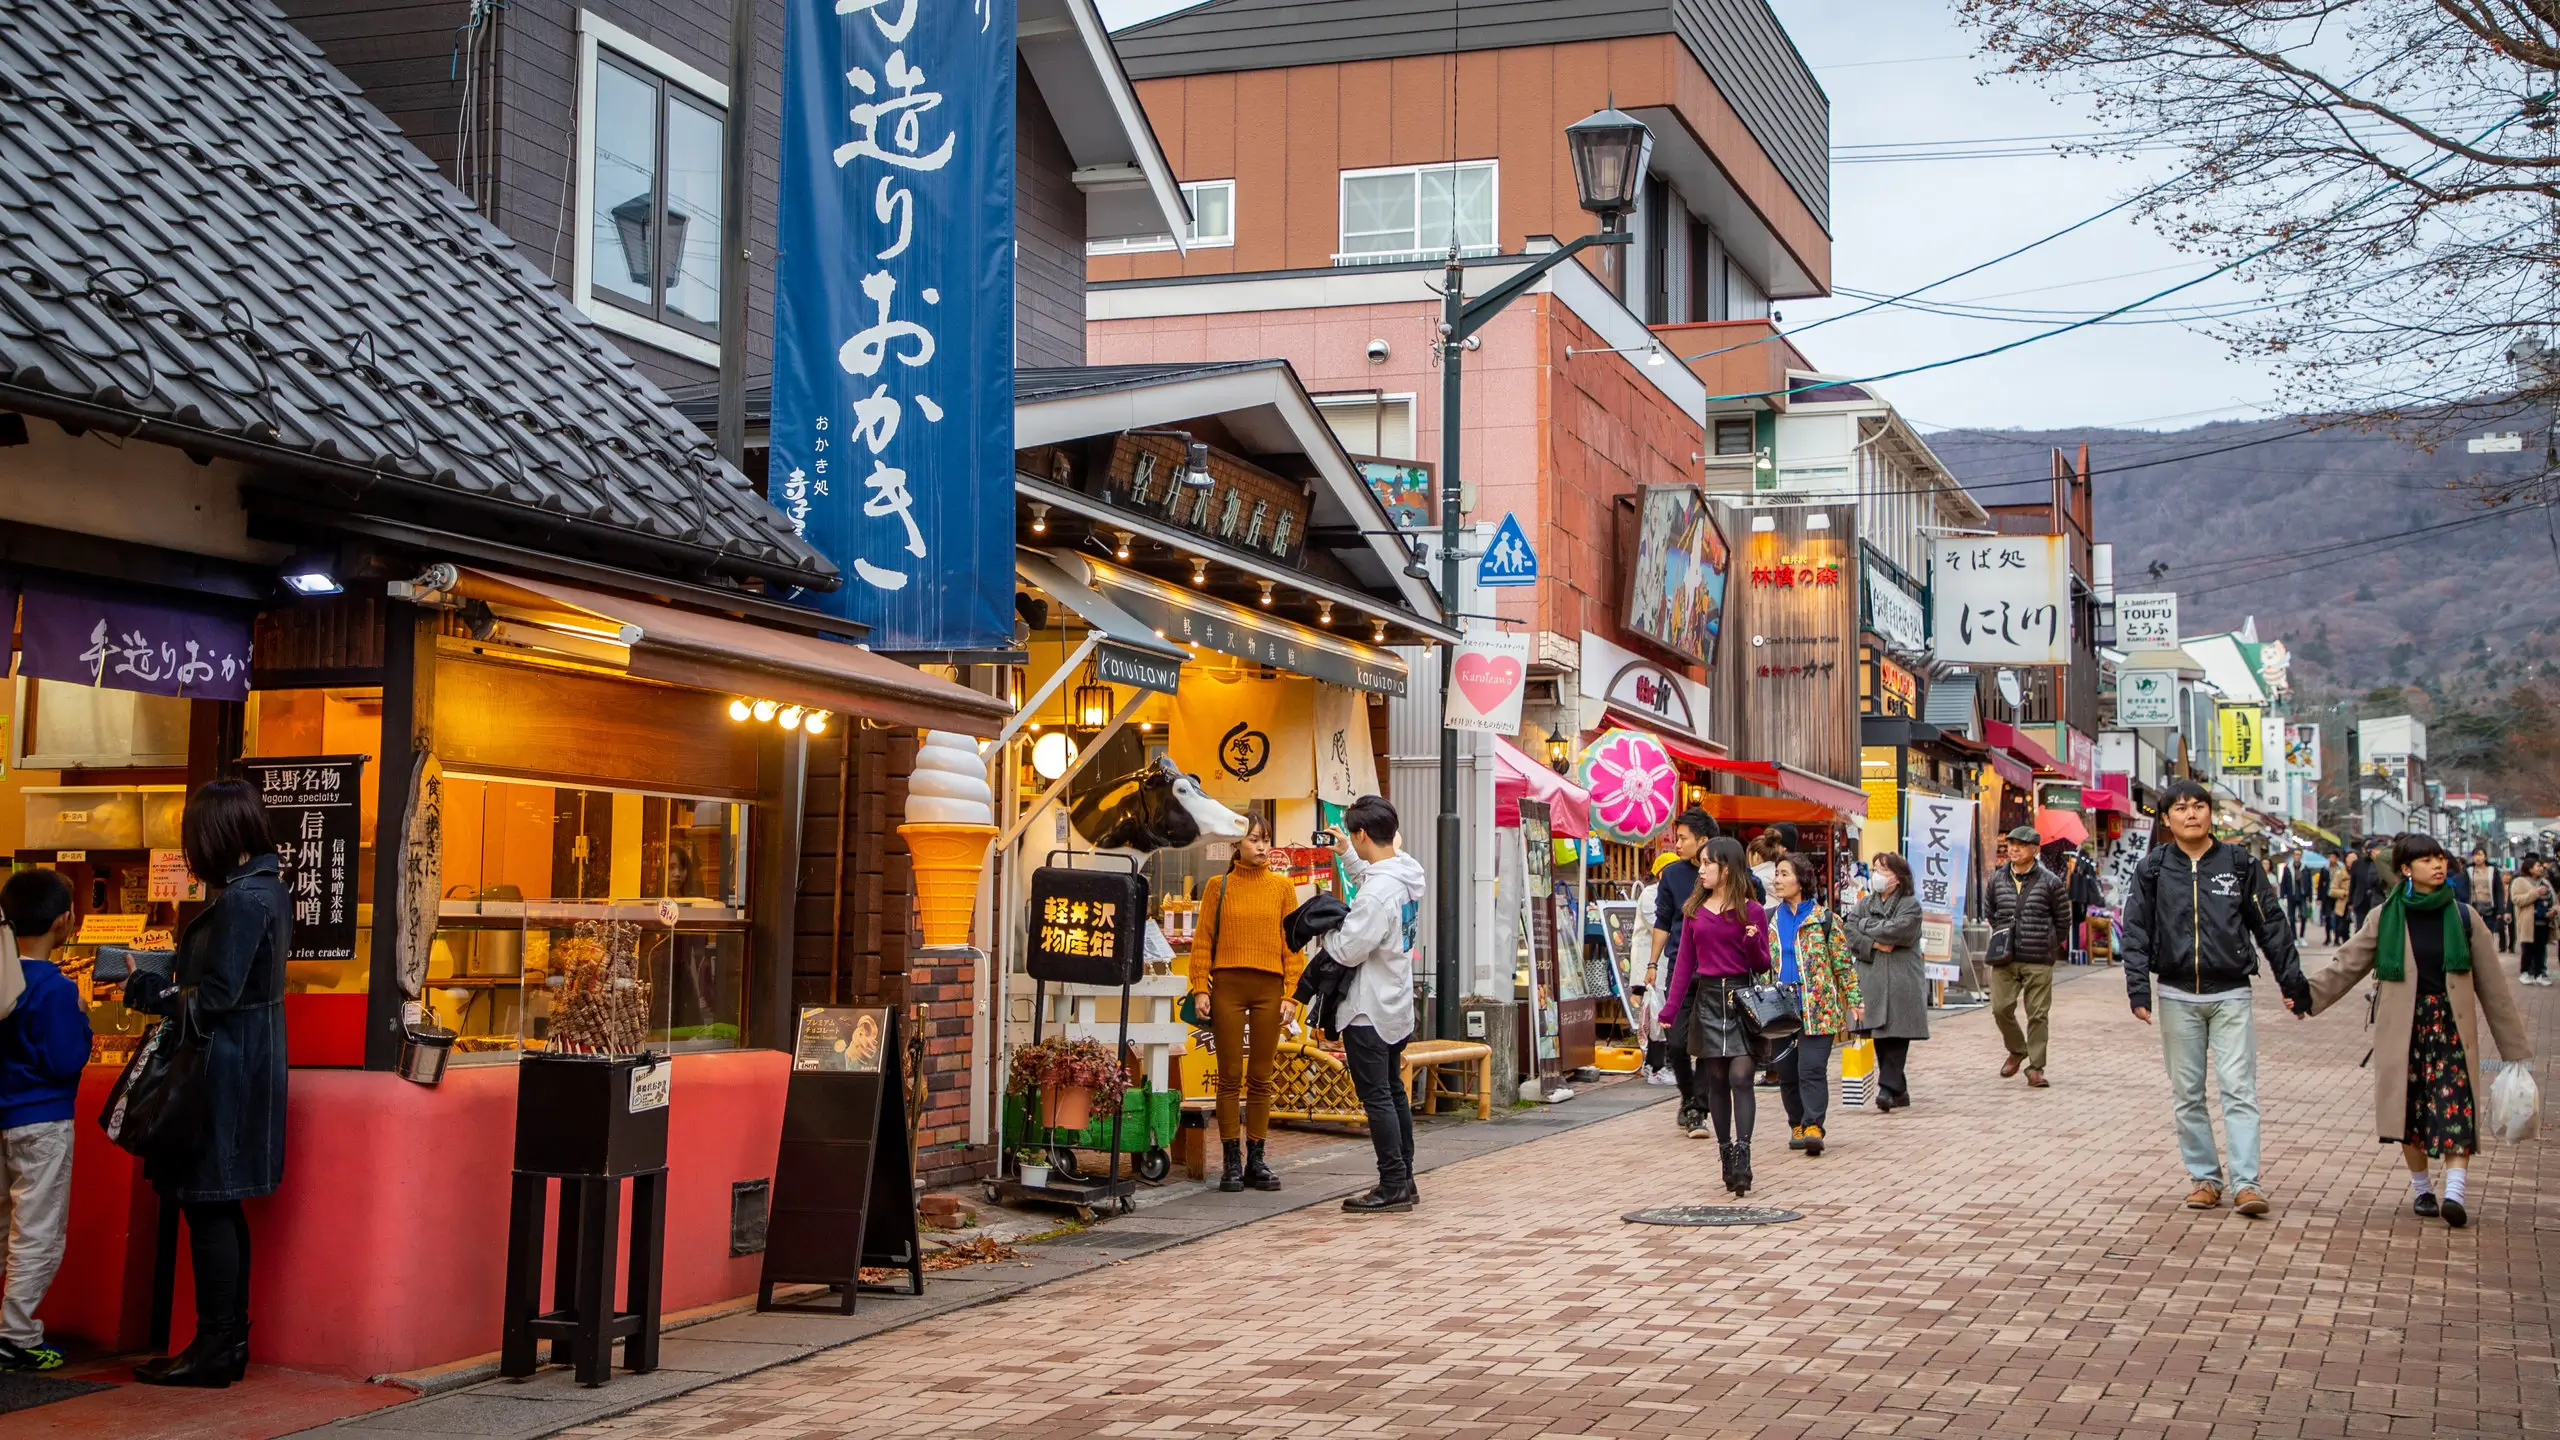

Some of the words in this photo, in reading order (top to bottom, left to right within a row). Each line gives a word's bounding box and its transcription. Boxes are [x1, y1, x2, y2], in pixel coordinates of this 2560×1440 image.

[813, 415, 829, 497] おかき処
[1131, 449, 1292, 558] 軽井沢物産館
[1945, 548, 2026, 571] そば処
[1960, 601, 2057, 647] にし川
[2122, 609, 2172, 620] TOUFU
[1182, 616, 1296, 666] 軽井沢物産館
[2126, 622, 2169, 636] とうふ
[1100, 649, 1177, 689] karuizawa
[1462, 670, 1513, 685] Karuizawa
[262, 768, 341, 792] 長野名物
[262, 794, 293, 804] Nagano
[298, 792, 340, 803] specialty
[296, 811, 325, 926] 信州味噌
[330, 838, 345, 924] 信州味噌米菓
[1043, 895, 1117, 929] 軽井沢
[296, 948, 314, 959] rice
[318, 948, 351, 958] cracker
[1040, 925, 1116, 958] 物産館
[805, 1026, 840, 1035] チョコレート
[807, 1019, 835, 1027] プレミアム
